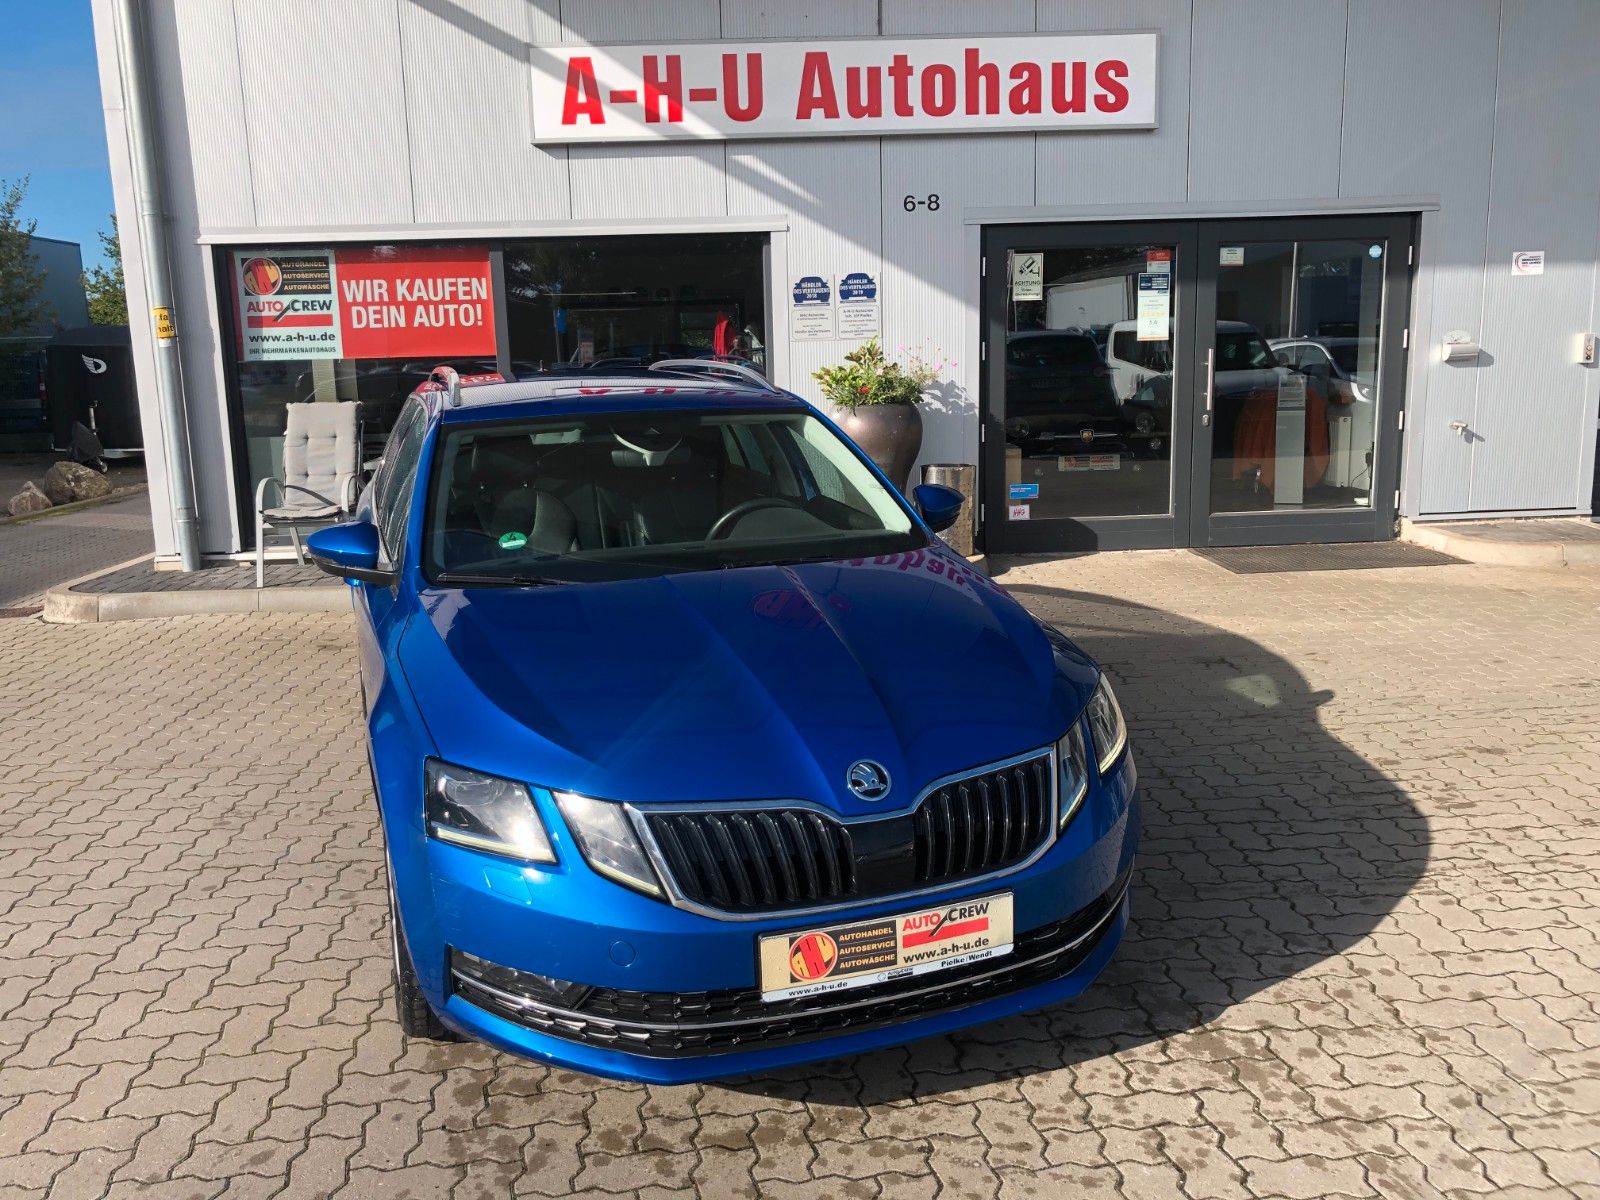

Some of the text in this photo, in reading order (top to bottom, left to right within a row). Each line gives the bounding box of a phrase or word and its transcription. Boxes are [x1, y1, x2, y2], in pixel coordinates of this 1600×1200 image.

[561, 47, 1130, 125] A-H-U Autohaus
[903, 193, 940, 212] 6-8
[342, 278, 488, 302] WIR KAUFEN
[247, 299, 333, 313] AUTO CREW
[352, 303, 483, 329] DEIN AUTO!
[249, 332, 336, 343] www.a-h-u.de
[262, 346, 336, 354] MEHRMARKENAUTOHAUS
[903, 902, 989, 931] AUTO CREW
[839, 928, 893, 942] AUTOHANDEL
[839, 940, 895, 955] AUTOSERVICE
[903, 938, 989, 963] www.a-h-u.de
[839, 954, 895, 969] AUTOWÄSCHE
[789, 982, 848, 997] www.a-h-u.de
